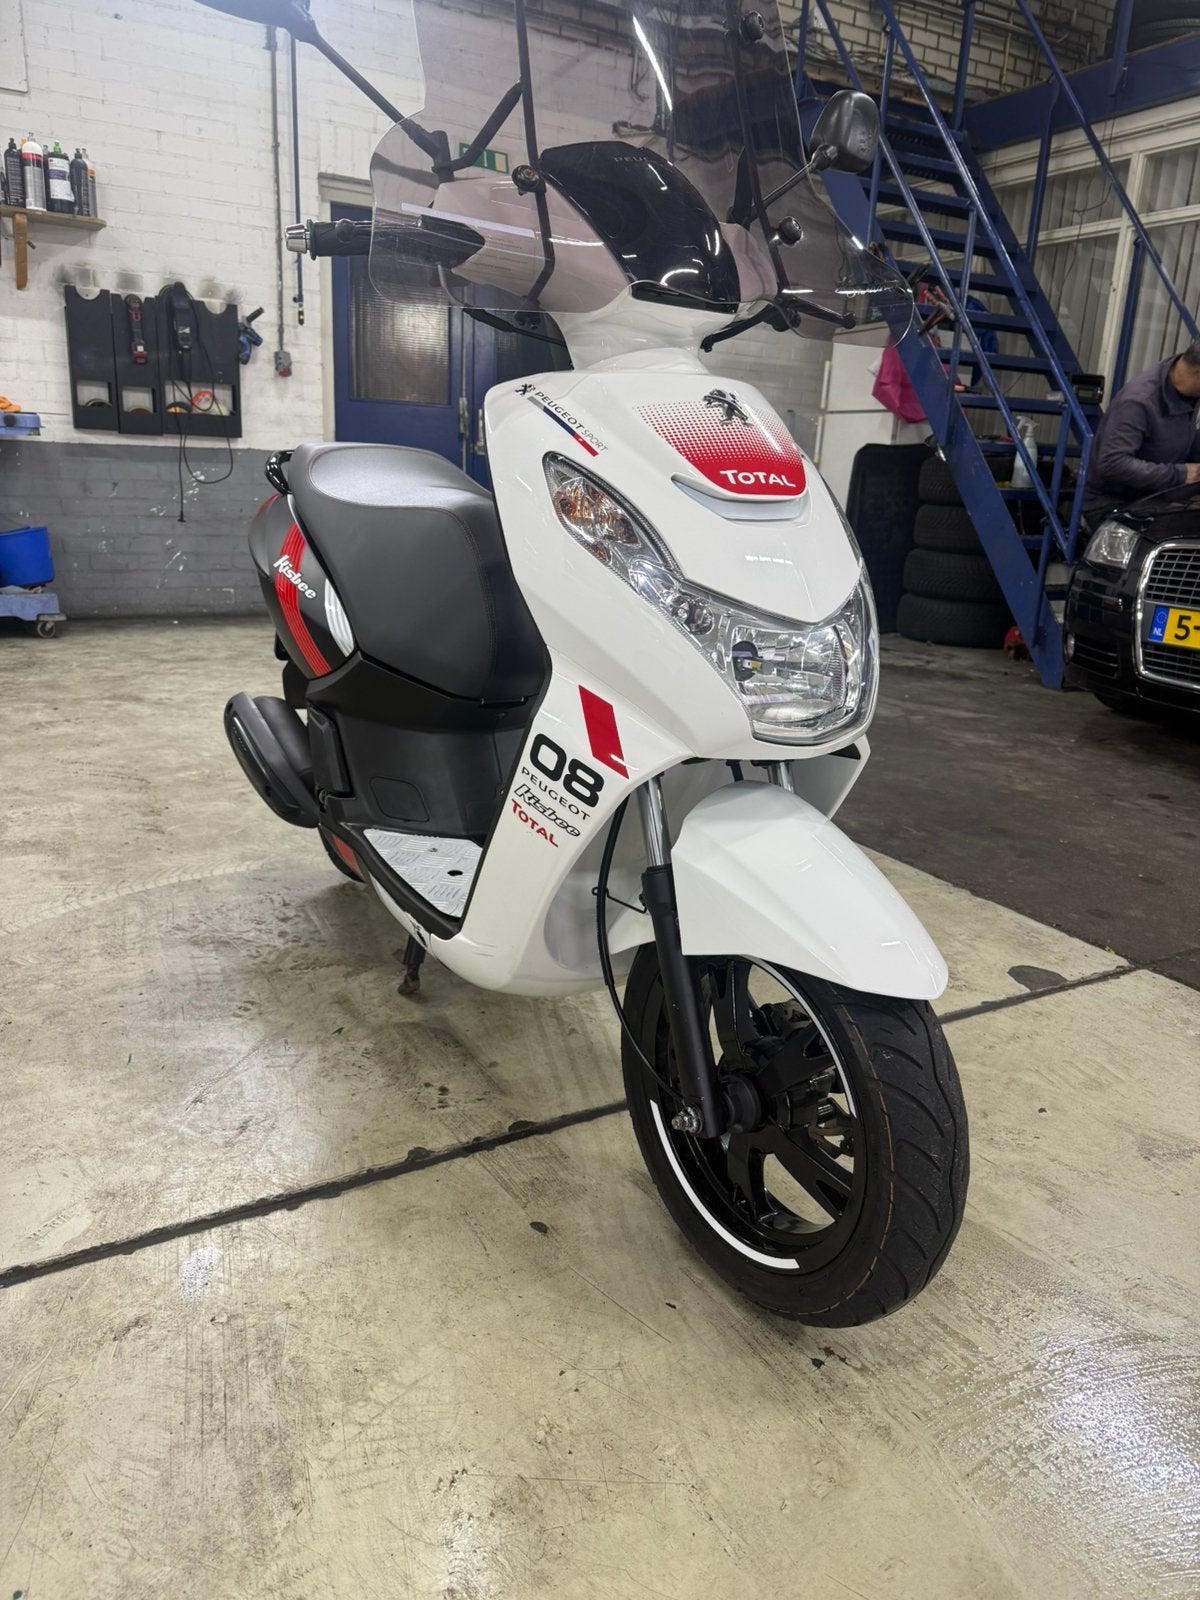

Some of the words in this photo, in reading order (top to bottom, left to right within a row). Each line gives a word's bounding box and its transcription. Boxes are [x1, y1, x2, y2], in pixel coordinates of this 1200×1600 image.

[534, 391, 585, 429] PEUGEOT
[581, 429, 608, 452] SPORT
[719, 469, 796, 488] TOTAL
[1152, 627, 1163, 637] NL
[521, 766, 590, 820] PEUGEOT
[530, 733, 604, 808] 08
[511, 798, 558, 848] TOTAL
